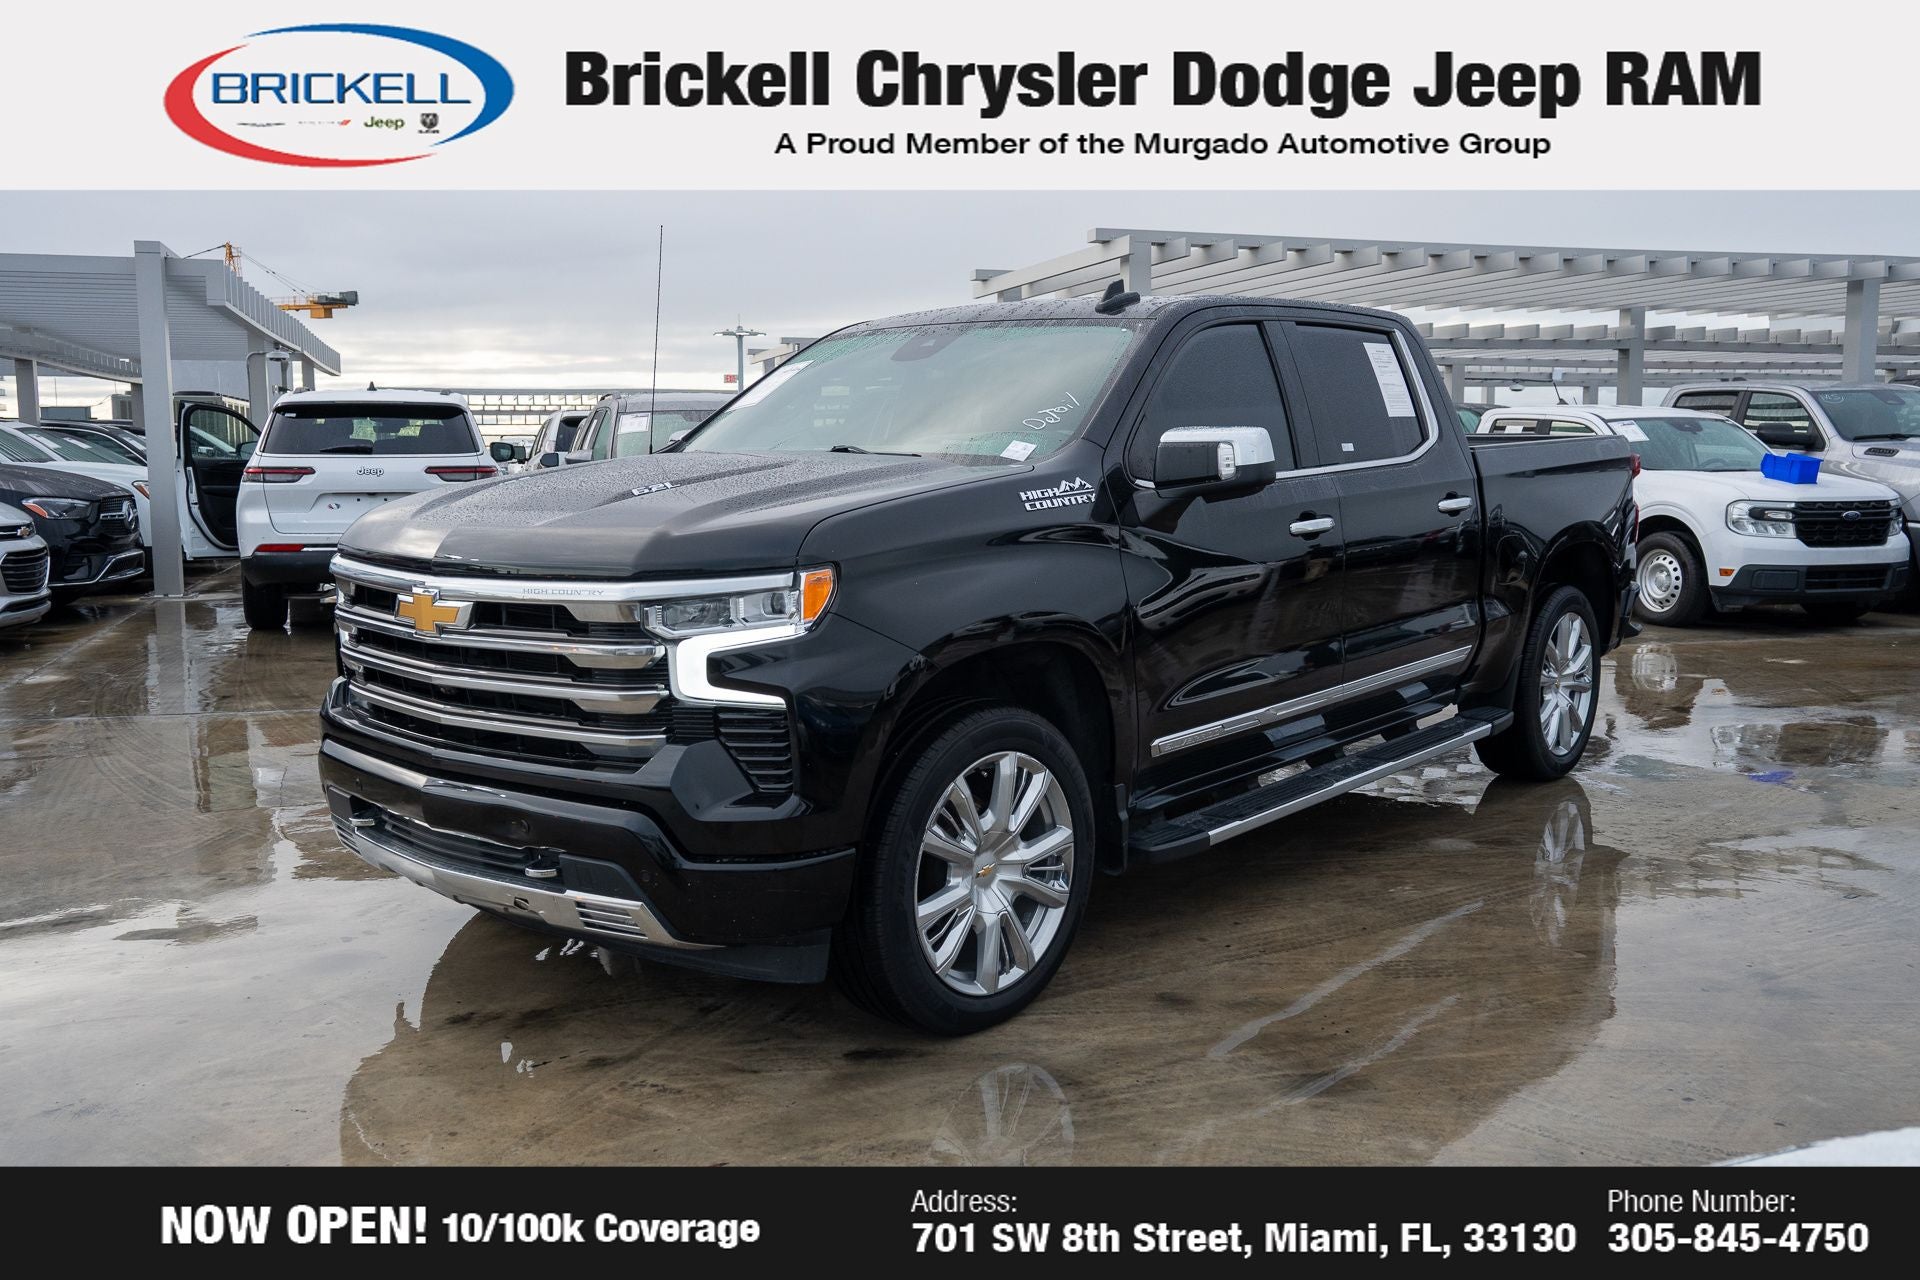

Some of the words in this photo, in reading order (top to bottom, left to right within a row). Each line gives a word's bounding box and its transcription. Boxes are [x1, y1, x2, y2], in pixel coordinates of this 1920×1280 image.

[356, 467, 384, 477] Jeep
[1019, 487, 1060, 502] HIGH
[1024, 493, 1096, 511] COUNTRY
